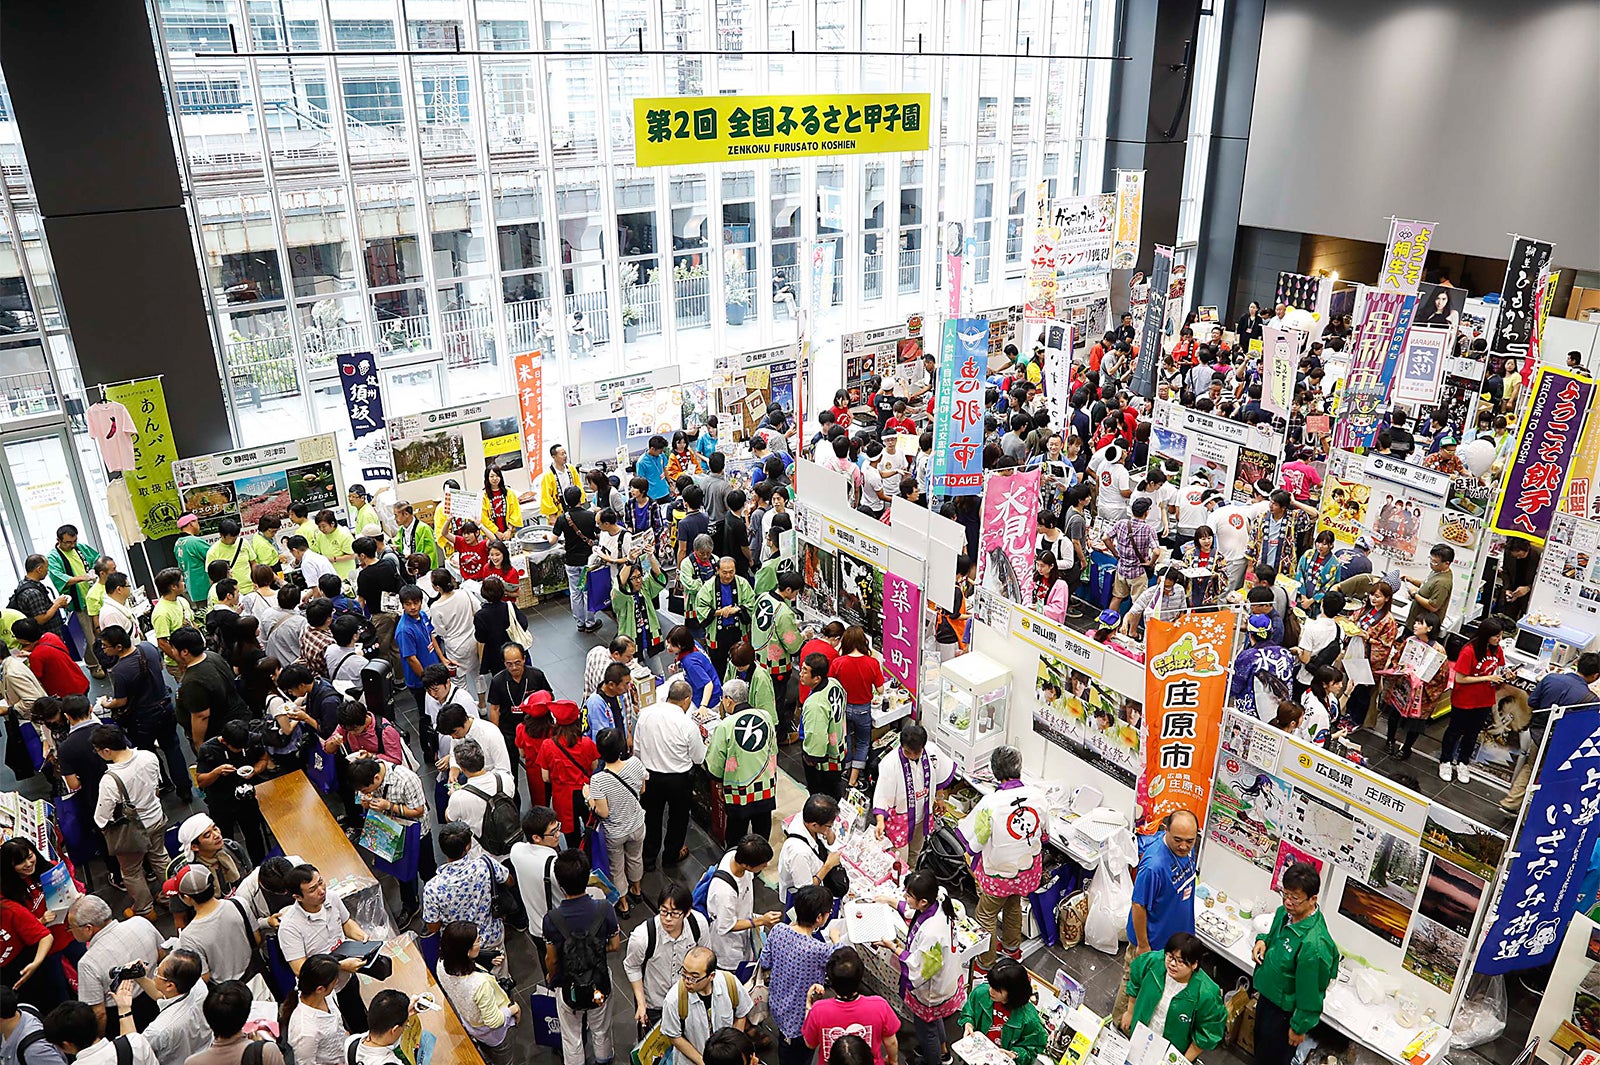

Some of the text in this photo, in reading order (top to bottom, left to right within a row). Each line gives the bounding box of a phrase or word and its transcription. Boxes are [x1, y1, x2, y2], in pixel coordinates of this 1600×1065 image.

[645, 103, 921, 143] 第2回 全国ふるさと甲子園
[727, 139, 856, 155] ZENKOKU FURUSATO KOSHIEN
[1385, 241, 1412, 288] 桐生へ
[1404, 228, 1431, 285] ようこそ
[140, 397, 166, 468] あんバタ
[438, 411, 458, 421] 長野県
[463, 407, 482, 416] 須坂市
[1196, 417, 1214, 429] 千葉県
[1218, 424, 1243, 437] いすみ市
[1517, 375, 1554, 465] WELCOME TO CHOSHI
[233, 452, 257, 465] 静岡県
[263, 447, 287, 458] 河津町
[1384, 462, 1408, 477] 栃木県
[1413, 471, 1438, 485] 足利市
[1513, 379, 1581, 534] ようこそ銚子へ
[1455, 478, 1477, 490] 足利
[988, 480, 1032, 555] 氷見
[836, 529, 856, 545] 福岡県
[860, 539, 880, 556] 築上町
[890, 579, 913, 680] 築上町
[1032, 622, 1057, 644] 岡山県
[1064, 639, 1091, 660] 赤磐市
[1164, 680, 1198, 769] 庄原市
[1167, 773, 1191, 781] 広島県
[1168, 779, 1204, 797] 庄原市
[1315, 762, 1354, 789] 広島県
[1364, 786, 1407, 813] 庄原市
[1492, 803, 1573, 961] いざなみ街道
